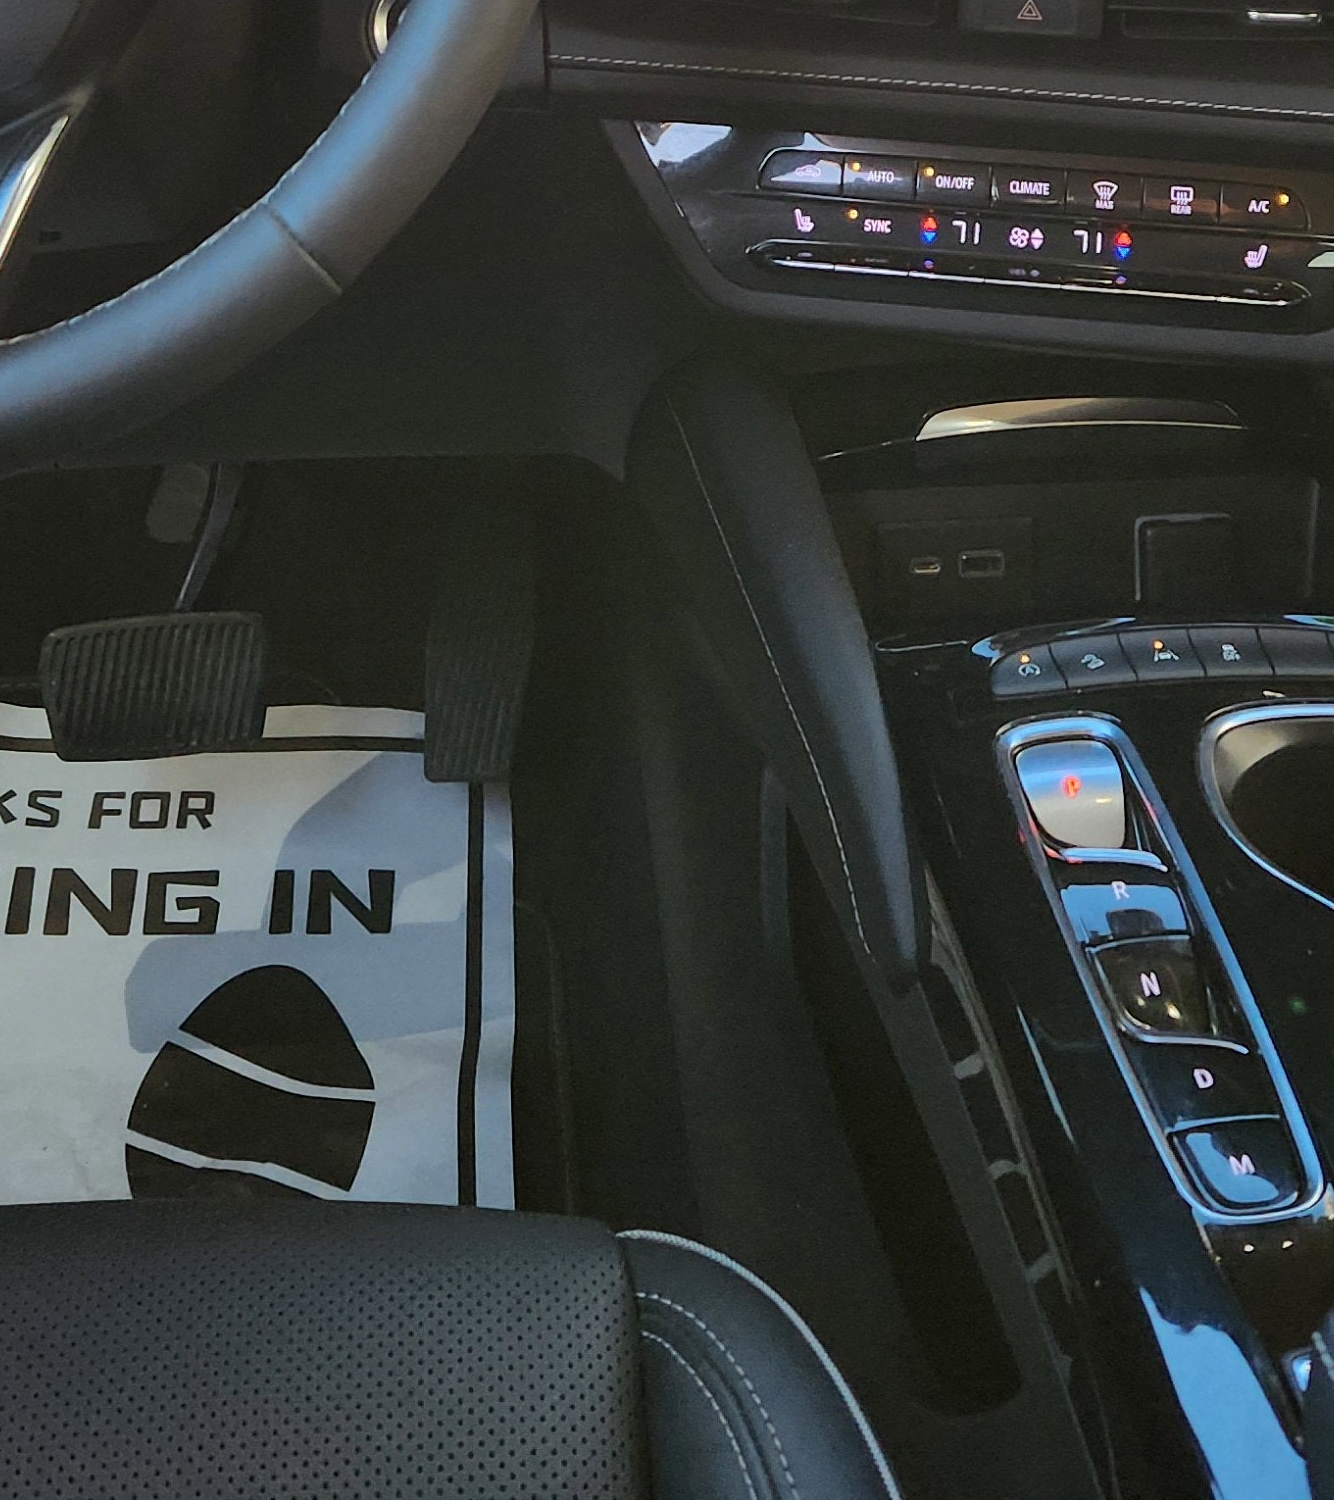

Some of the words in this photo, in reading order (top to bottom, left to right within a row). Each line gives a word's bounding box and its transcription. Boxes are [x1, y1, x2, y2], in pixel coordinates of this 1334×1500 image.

[867, 170, 895, 183] AUTO
[935, 176, 975, 191] ON/OFF
[1009, 180, 1051, 197] CLIMATE
[1095, 199, 1114, 210] MAX
[1170, 203, 1193, 216] REAR
[1248, 199, 1270, 214] A/C
[863, 219, 892, 234] SYNC
[951, 220, 981, 245] 71
[1073, 229, 1103, 254] 71
[1064, 775, 1081, 797] P
[87, 790, 216, 830] FOR
[1112, 880, 1129, 900] R
[269, 869, 397, 936] IN
[1141, 972, 1162, 997] N
[1193, 1068, 1215, 1090] D
[1230, 1153, 1255, 1176] M
